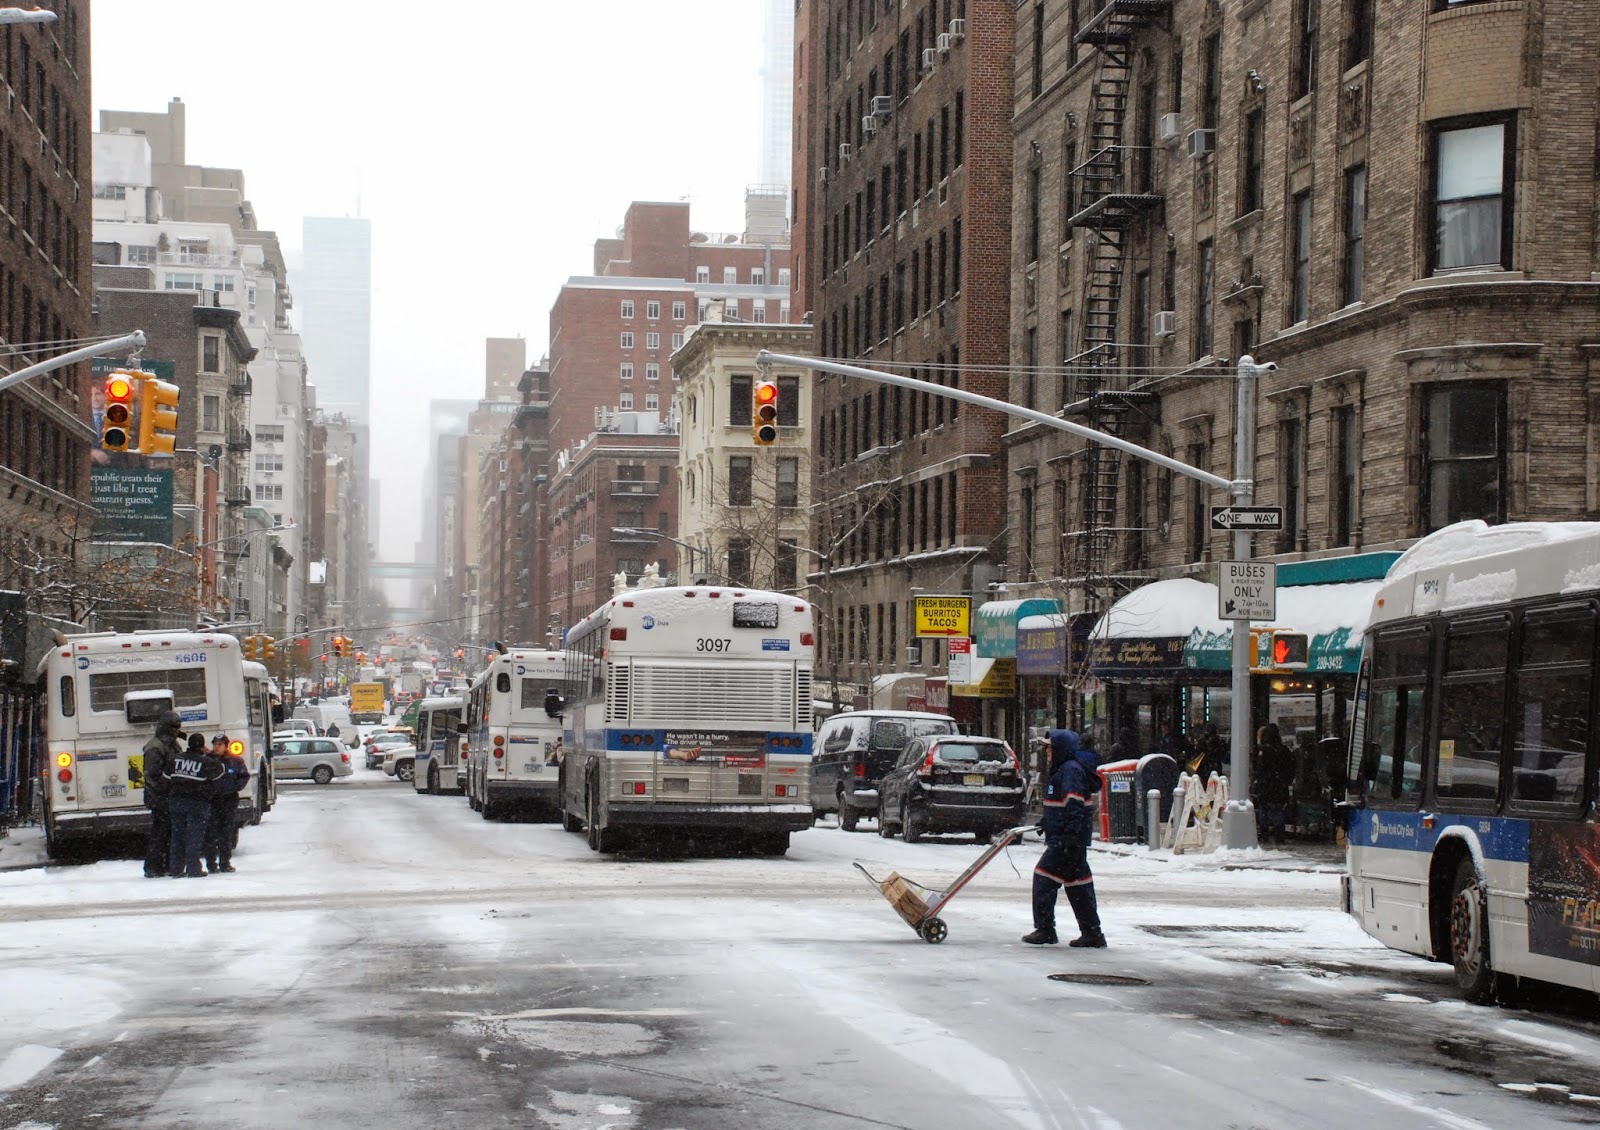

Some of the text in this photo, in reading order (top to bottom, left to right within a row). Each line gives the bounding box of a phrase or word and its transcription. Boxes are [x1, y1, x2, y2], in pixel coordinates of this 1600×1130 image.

[144, 474, 163, 483] their
[113, 484, 129, 493] like
[131, 484, 135, 493] I
[1219, 514, 1276, 523] ONE WAY
[1231, 566, 1266, 577] BUSES
[1234, 586, 1262, 598] ONLY
[918, 600, 967, 608] FRESH BURGERS
[923, 609, 961, 617] BURRITOS
[928, 619, 957, 627] TACOS
[696, 638, 731, 652] 3097
[175, 759, 202, 773] TWU
[1379, 823, 1388, 833] New
[1388, 823, 1396, 834] York
[1396, 824, 1405, 837] City
[1405, 824, 1415, 837] Bus
